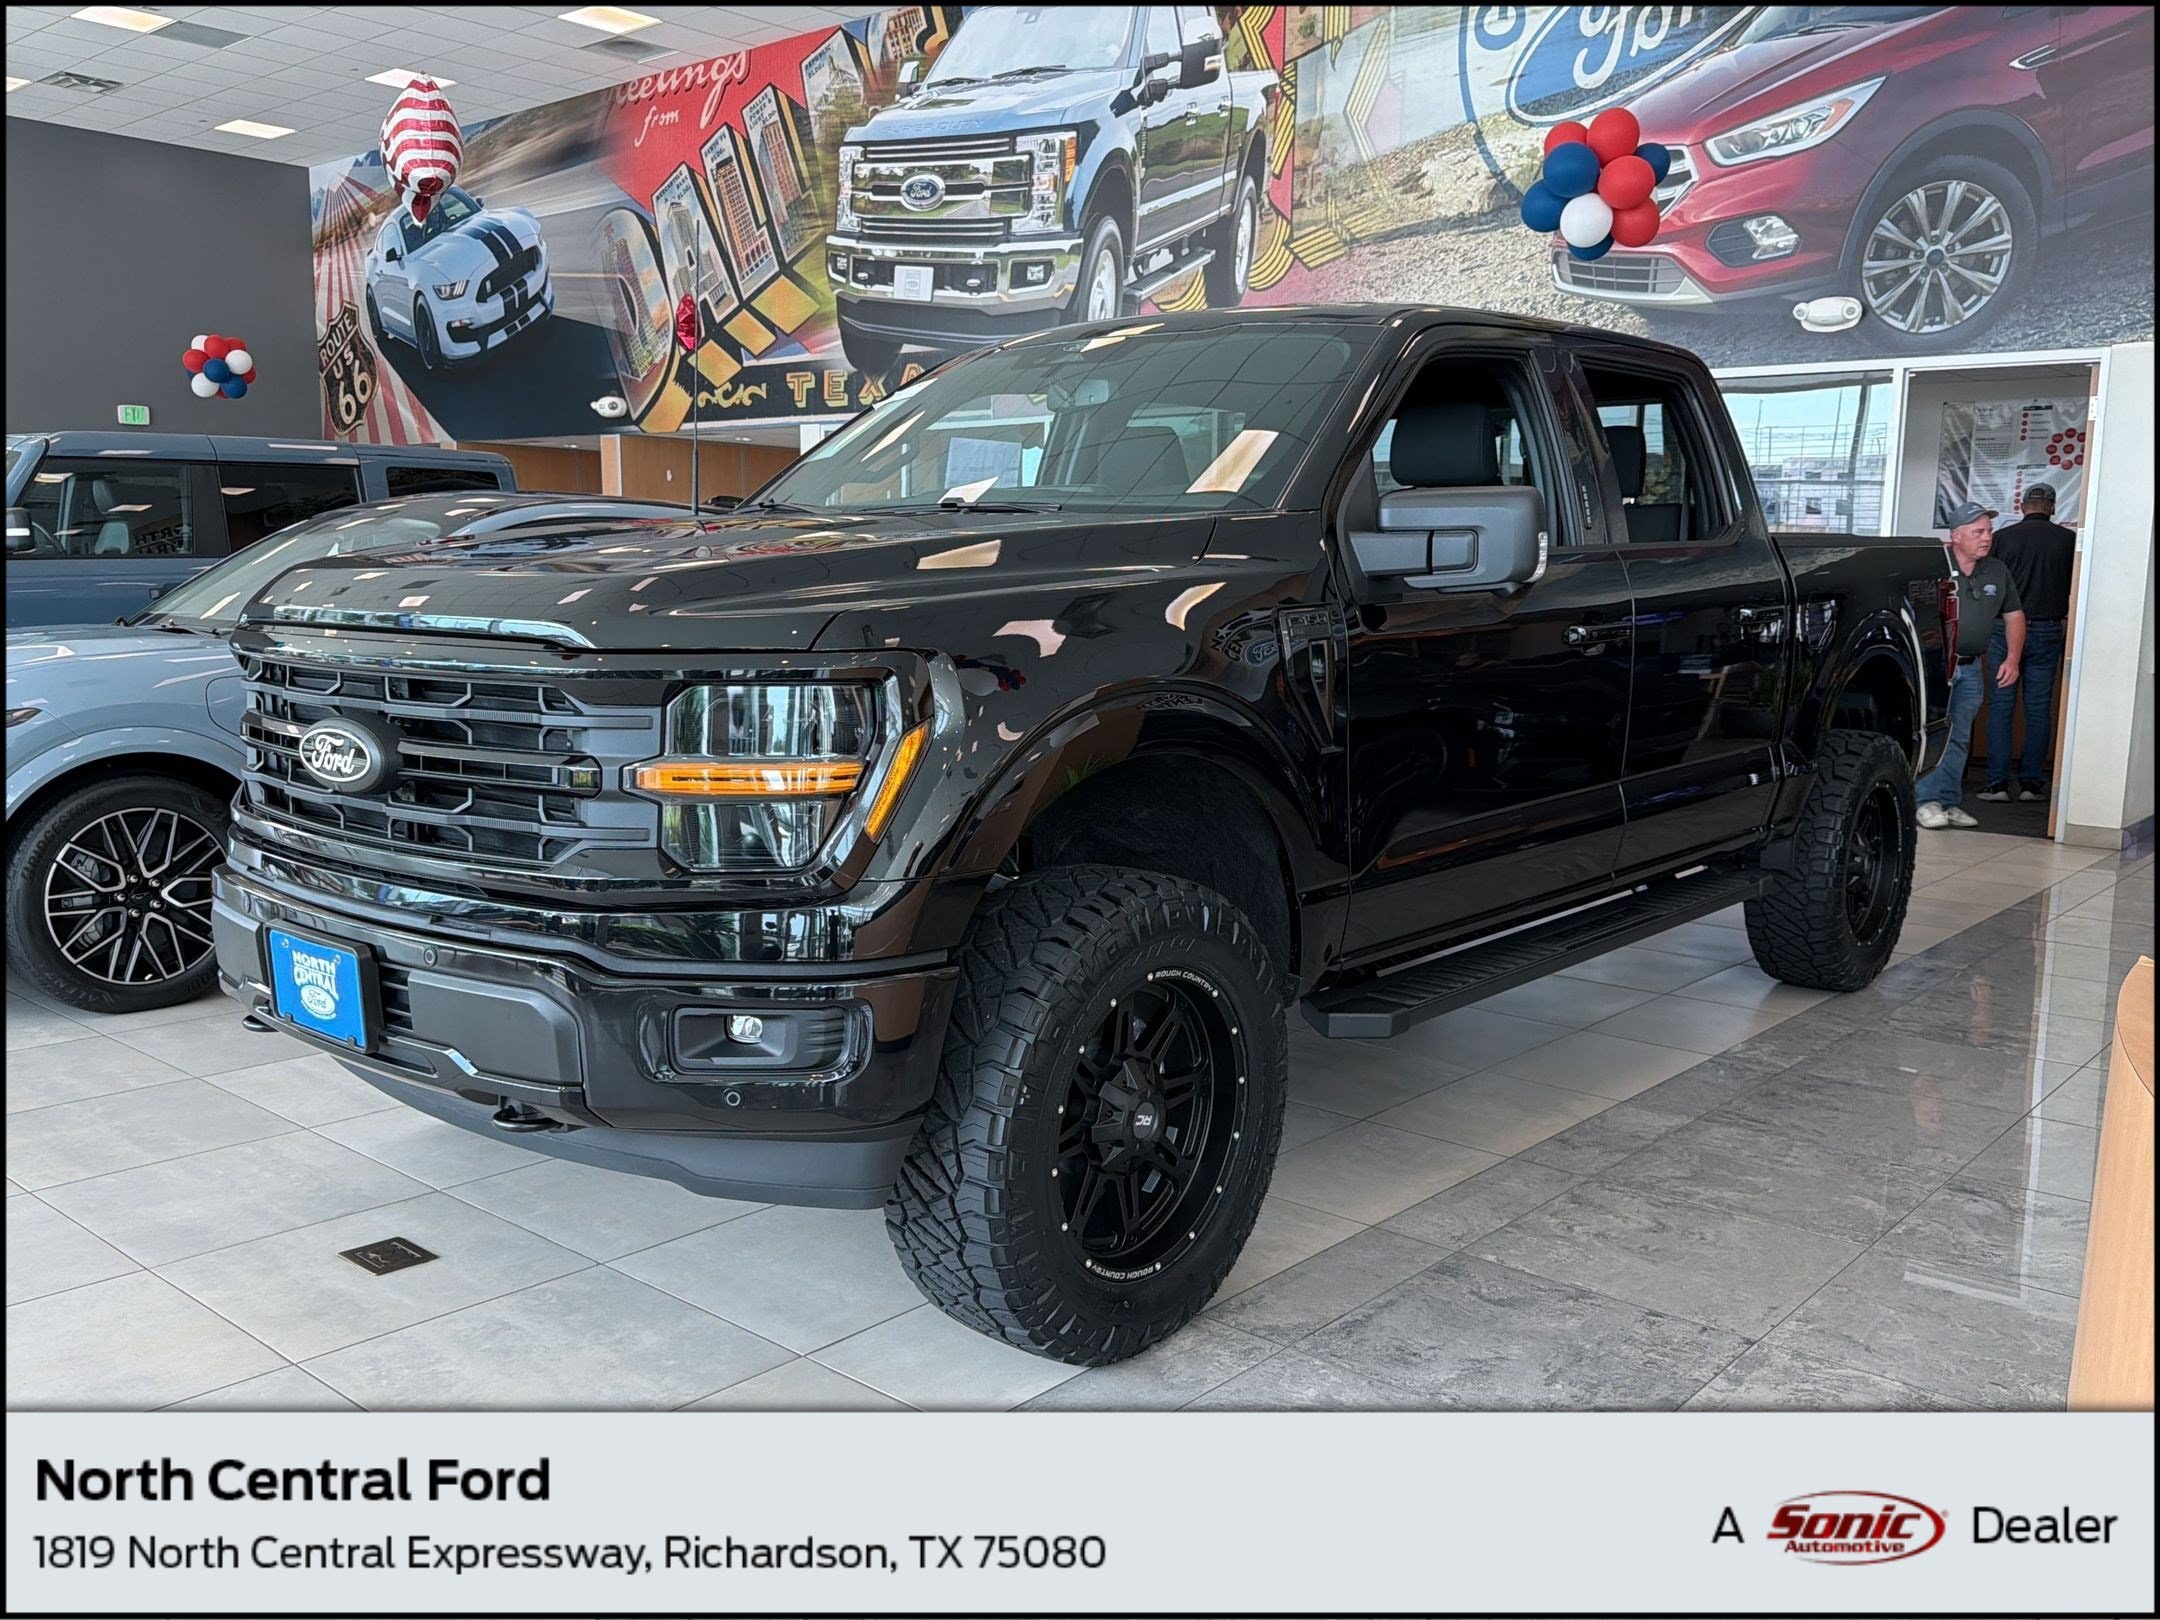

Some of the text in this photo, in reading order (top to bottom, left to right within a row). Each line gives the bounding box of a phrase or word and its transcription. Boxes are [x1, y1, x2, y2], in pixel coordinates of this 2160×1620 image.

[634, 105, 679, 147] from
[910, 182, 932, 199] Ford
[319, 312, 354, 368] ROUTE
[338, 359, 372, 425] 66
[786, 362, 923, 408] TEXA
[311, 735, 356, 774] Ford
[292, 949, 336, 975] NORTH
[293, 964, 340, 1001] CENTRAL
[1155, 969, 1213, 992] ROUGH COUNTRY
[306, 989, 327, 1010] Ford
[1135, 1114, 1153, 1126] RC
[1091, 1264, 1154, 1280] ROUGH COUNTRY
